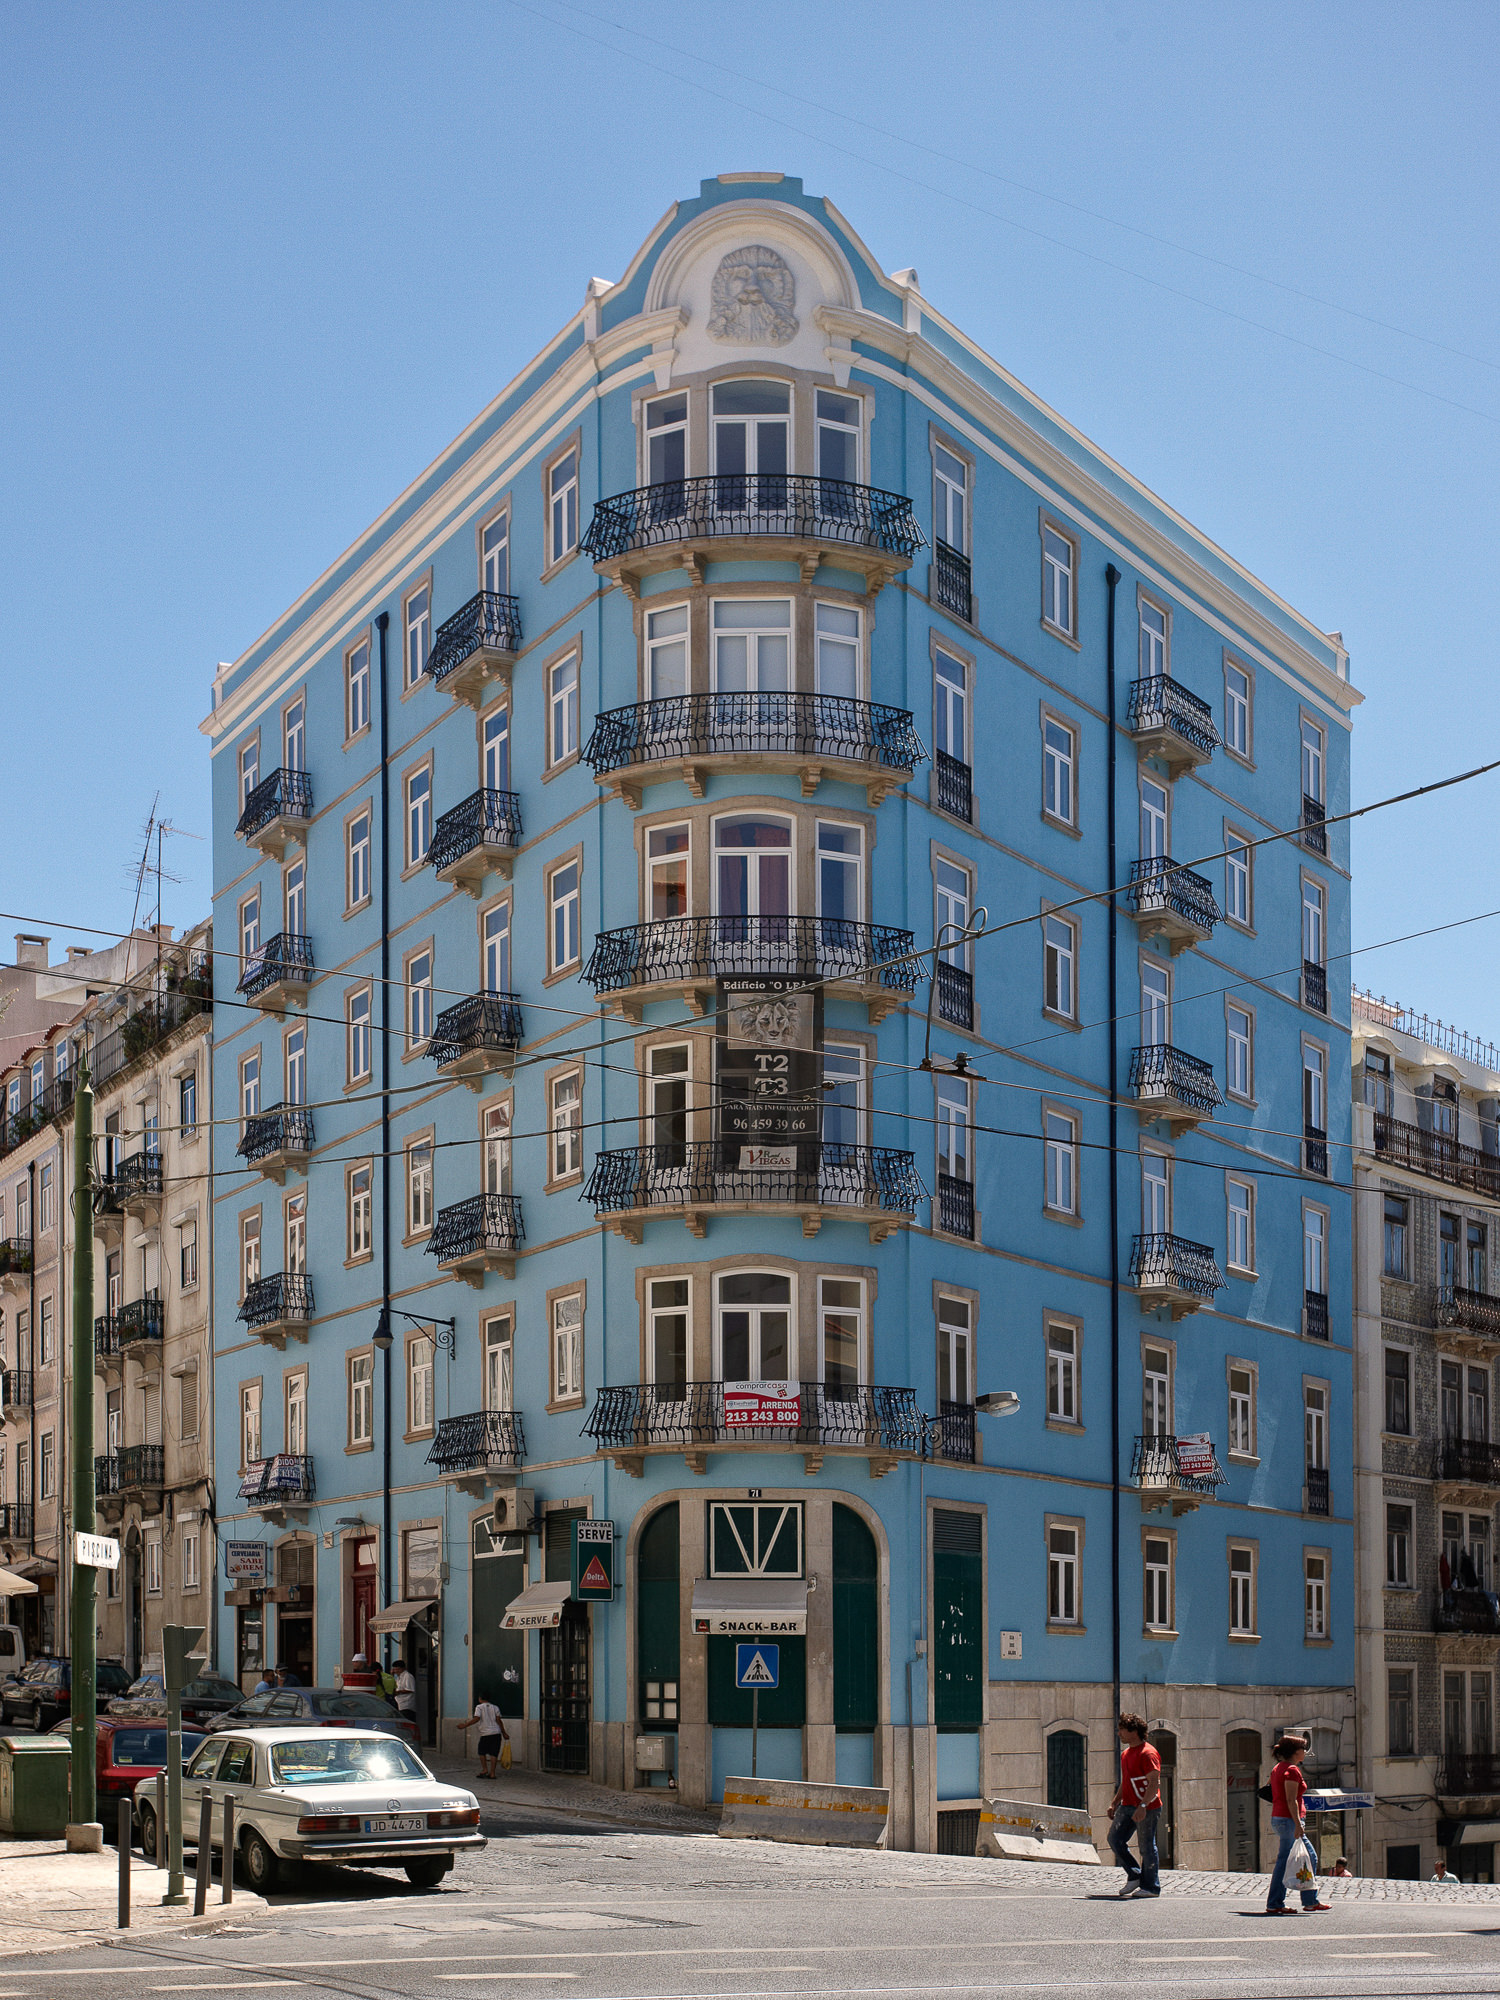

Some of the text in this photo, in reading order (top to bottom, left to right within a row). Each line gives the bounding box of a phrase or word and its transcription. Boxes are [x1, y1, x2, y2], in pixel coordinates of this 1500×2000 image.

[723, 981, 766, 990] Edifício
[754, 1054, 789, 1072] T2
[754, 1077, 789, 1095] T3
[733, 1118, 806, 1131] 96 459 39 66
[761, 1401, 799, 1410] ARRENDA
[726, 1411, 799, 1422] 213 243 800
[750, 1489, 759, 1498] 71
[578, 1529, 612, 1541] SERVE
[82, 1540, 113, 1560] PISCINA
[520, 1616, 548, 1625] SERVE
[719, 1621, 797, 1631] SNACK-BAR
